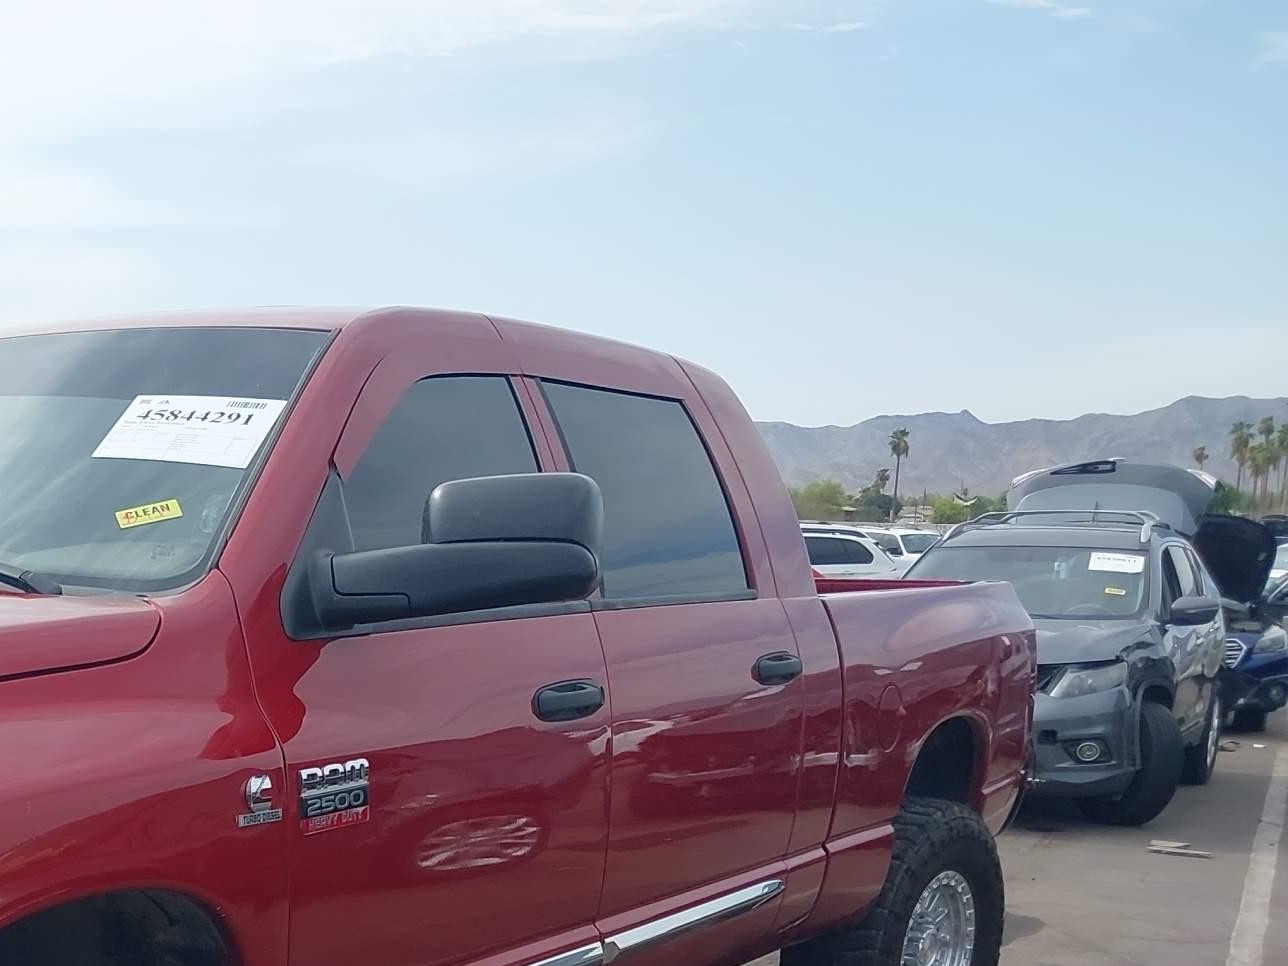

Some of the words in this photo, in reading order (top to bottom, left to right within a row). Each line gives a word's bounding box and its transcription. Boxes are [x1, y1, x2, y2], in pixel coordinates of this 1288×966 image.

[137, 409, 253, 426] 45844291
[124, 503, 171, 519] CLEAN
[300, 758, 370, 791] RAM
[306, 789, 365, 817] 2500
[308, 813, 339, 831] HEAVY
[341, 808, 364, 823] DUTY
